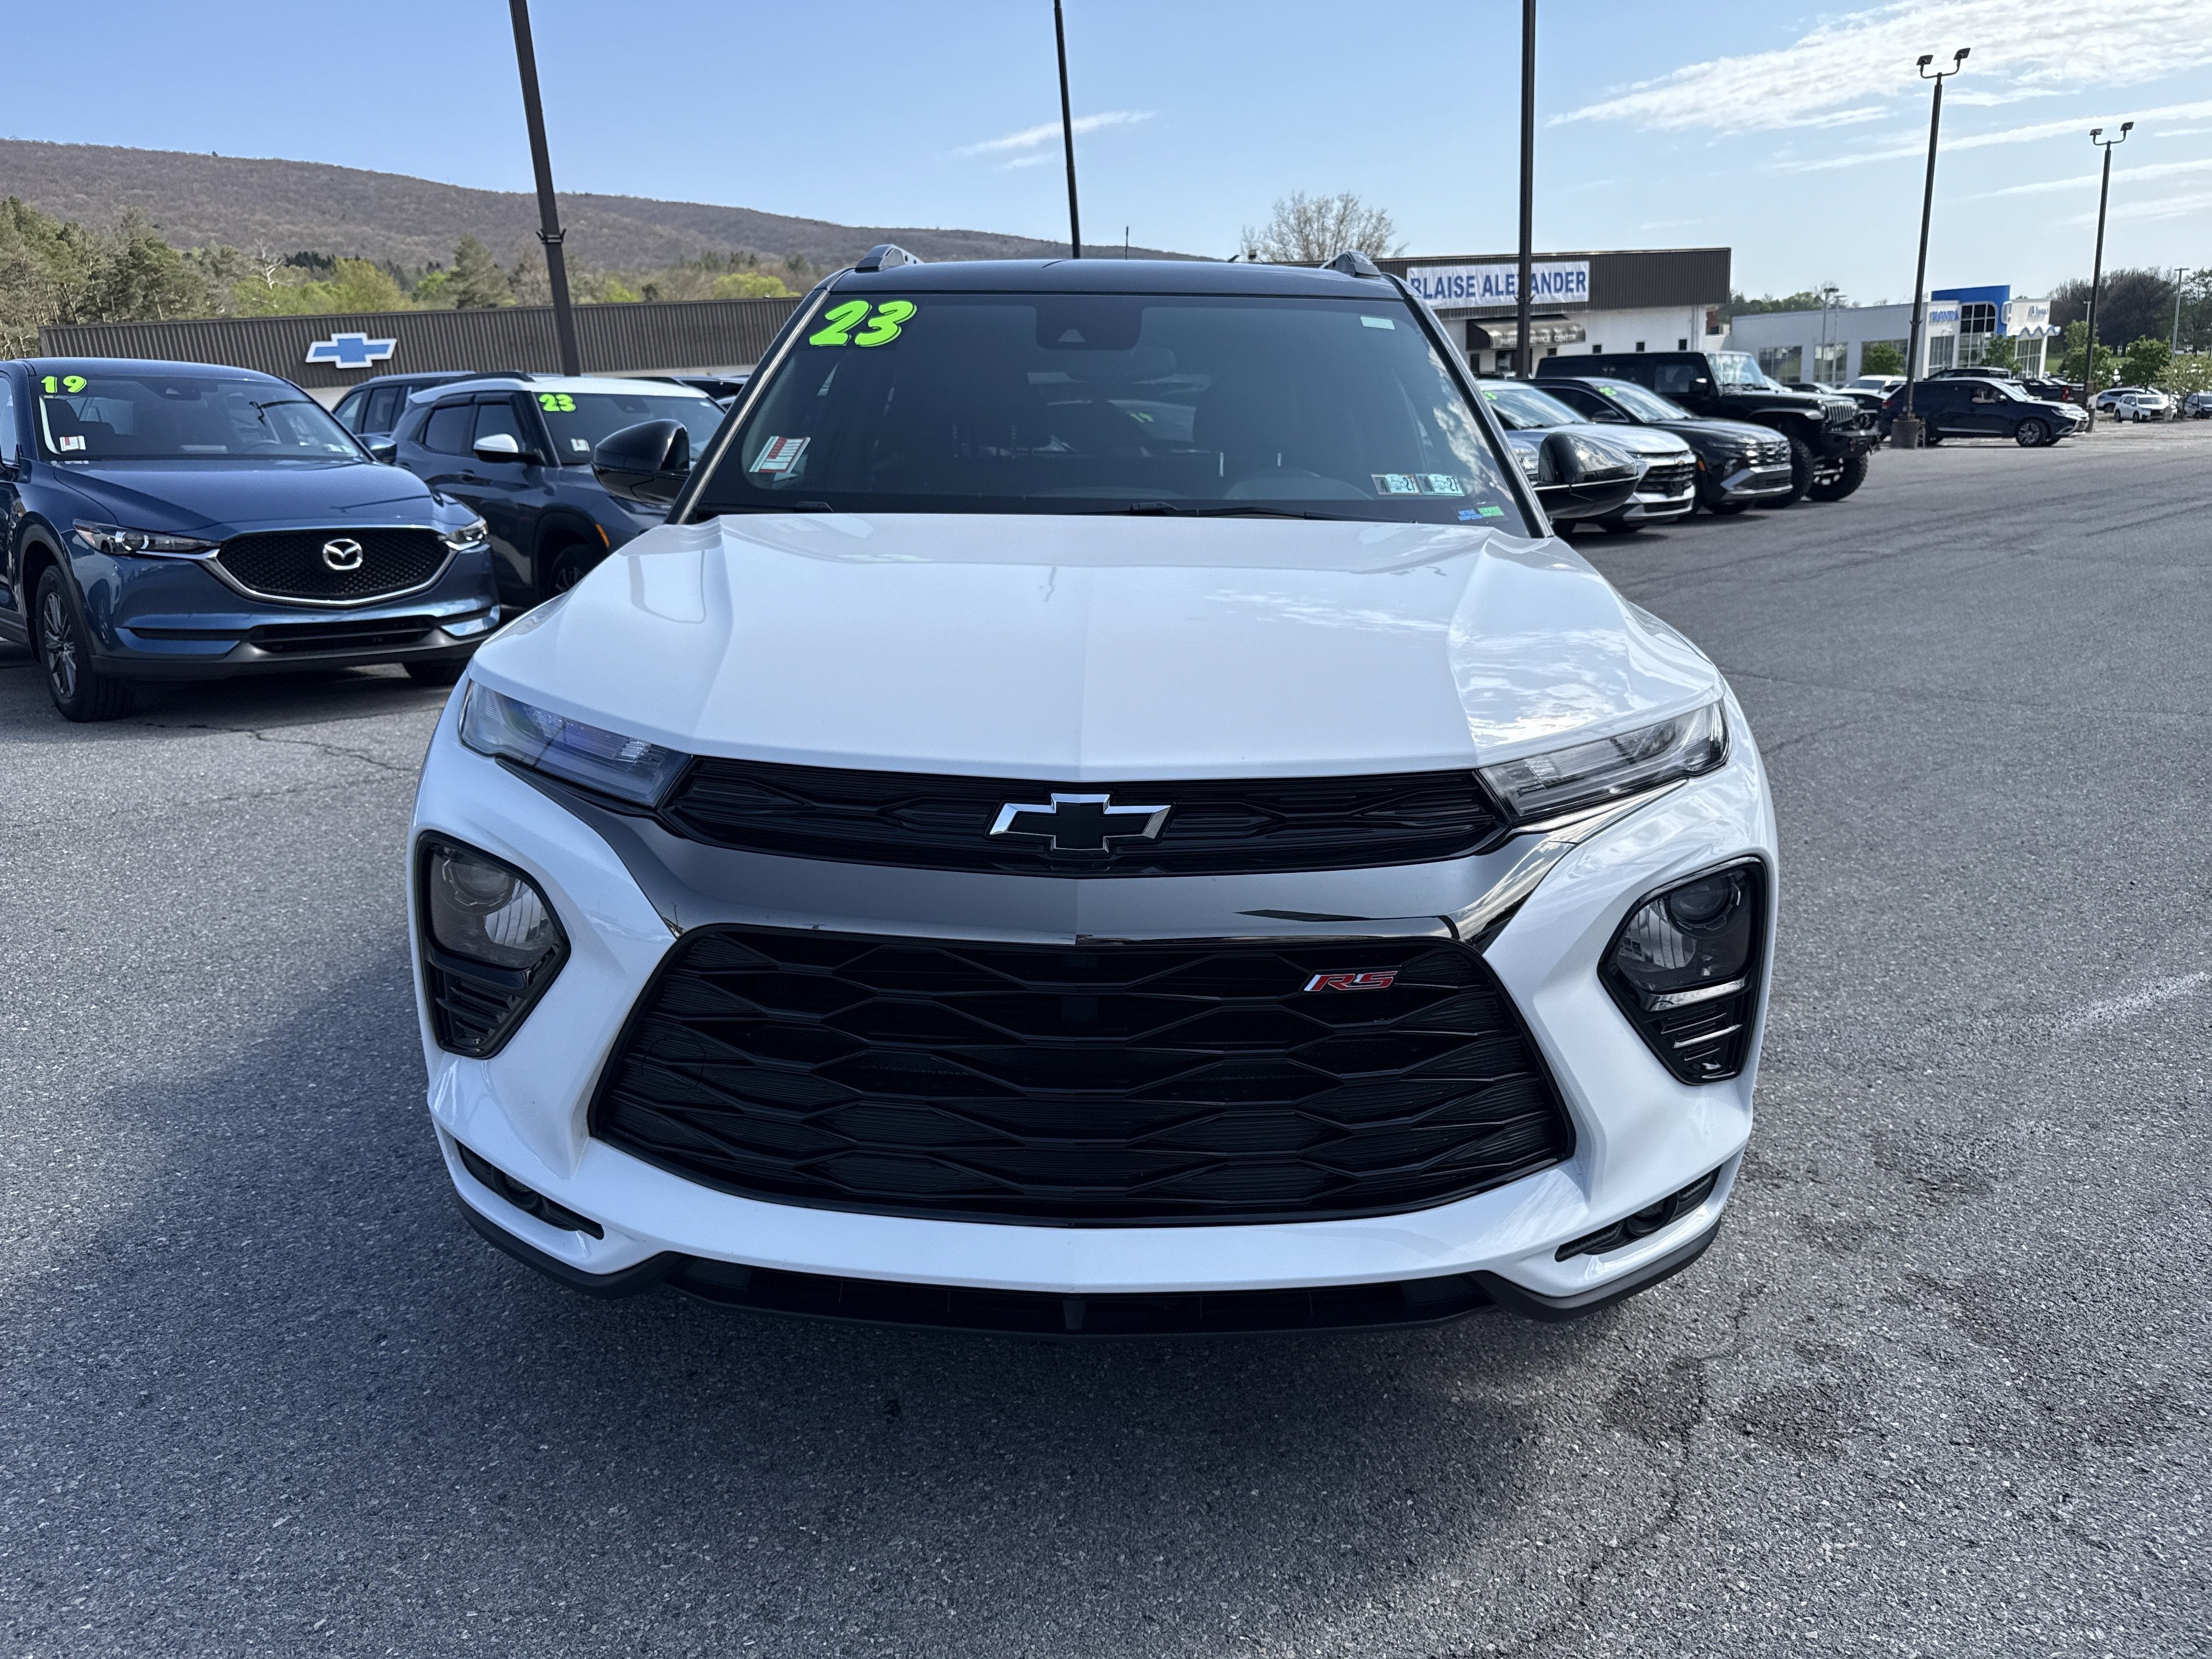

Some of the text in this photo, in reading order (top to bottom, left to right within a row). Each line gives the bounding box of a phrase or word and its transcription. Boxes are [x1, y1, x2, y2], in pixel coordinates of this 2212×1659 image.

[1411, 271, 1586, 300] BLAISE ALEANDER
[809, 301, 917, 347] 23
[1554, 334, 1576, 342] CENTER
[41, 375, 87, 393] 19
[539, 393, 576, 412] 23
[1402, 477, 1415, 492] 27
[1446, 477, 1458, 492] 27
[1304, 970, 1398, 991] RS
